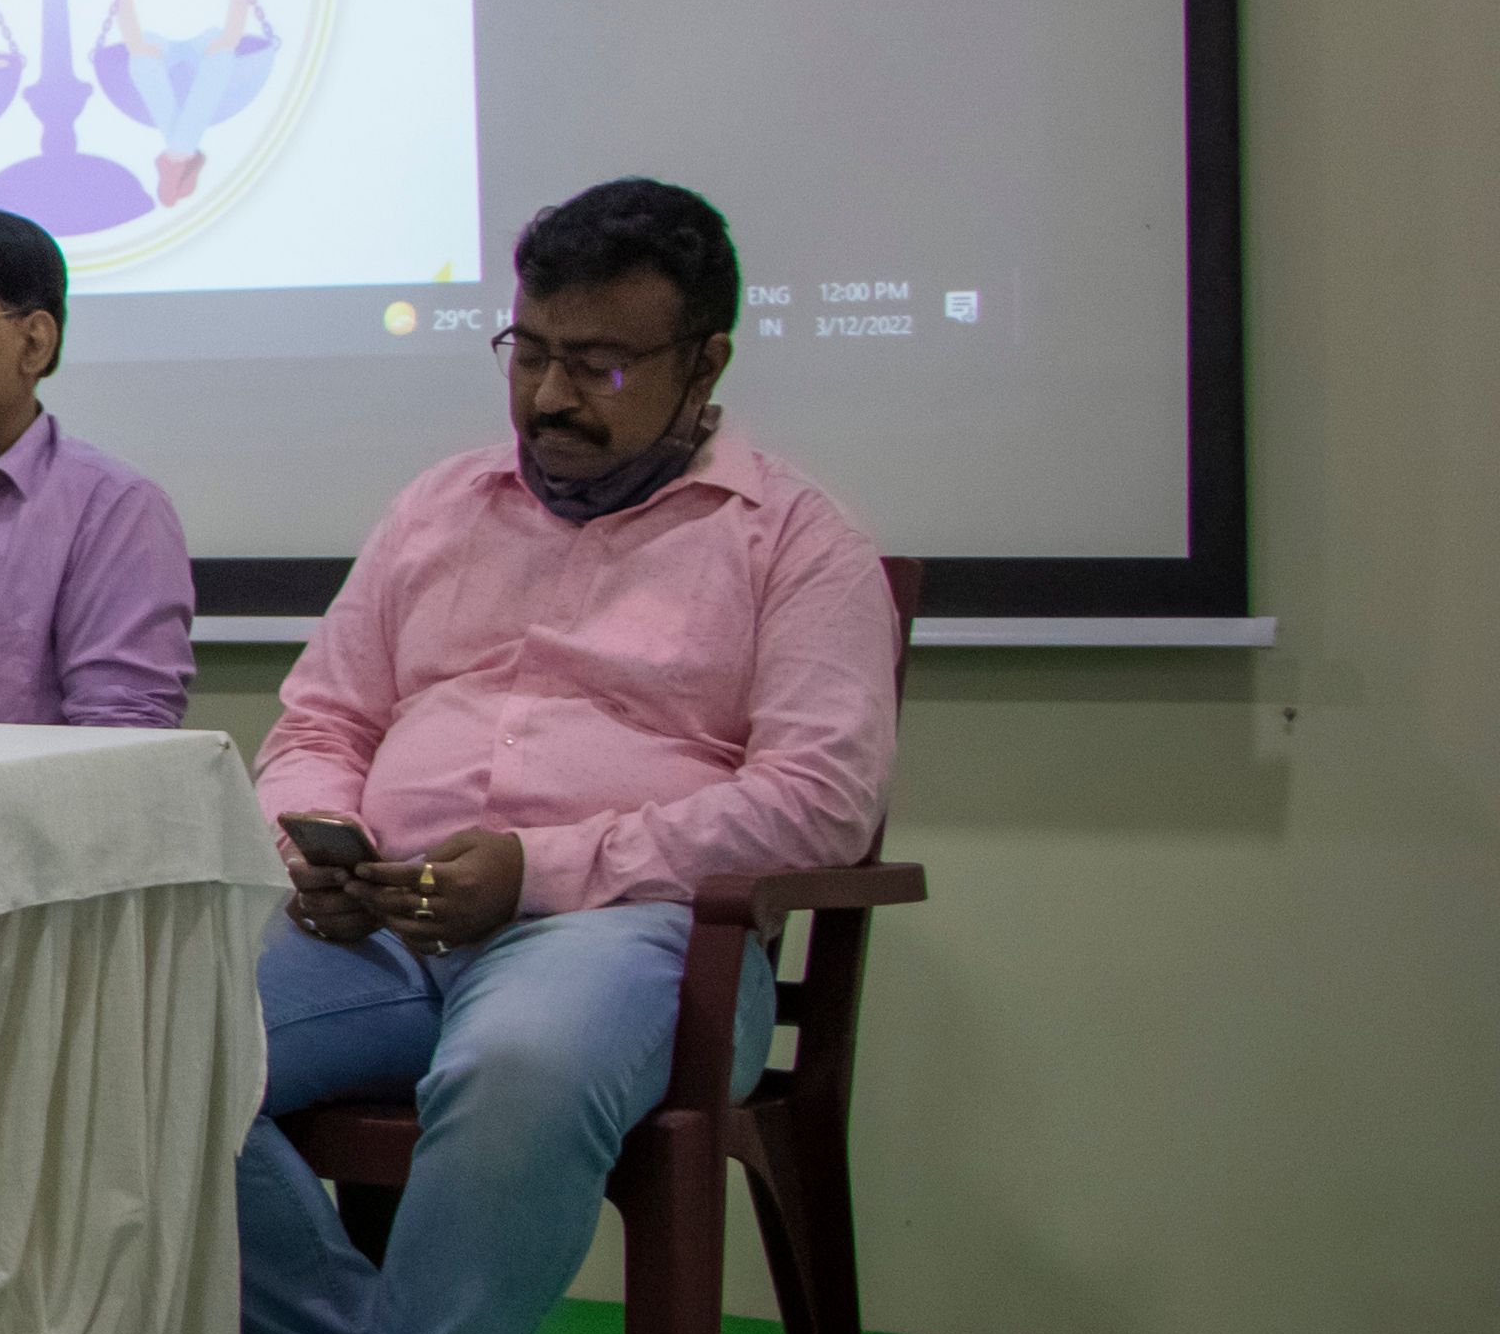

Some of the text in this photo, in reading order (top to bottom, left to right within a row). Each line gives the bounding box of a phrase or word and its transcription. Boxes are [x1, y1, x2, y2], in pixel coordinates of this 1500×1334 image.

[747, 285, 791, 306] ENG
[874, 281, 909, 300] PM
[759, 318, 782, 337] IN
[815, 316, 912, 336] 3/12/2022
